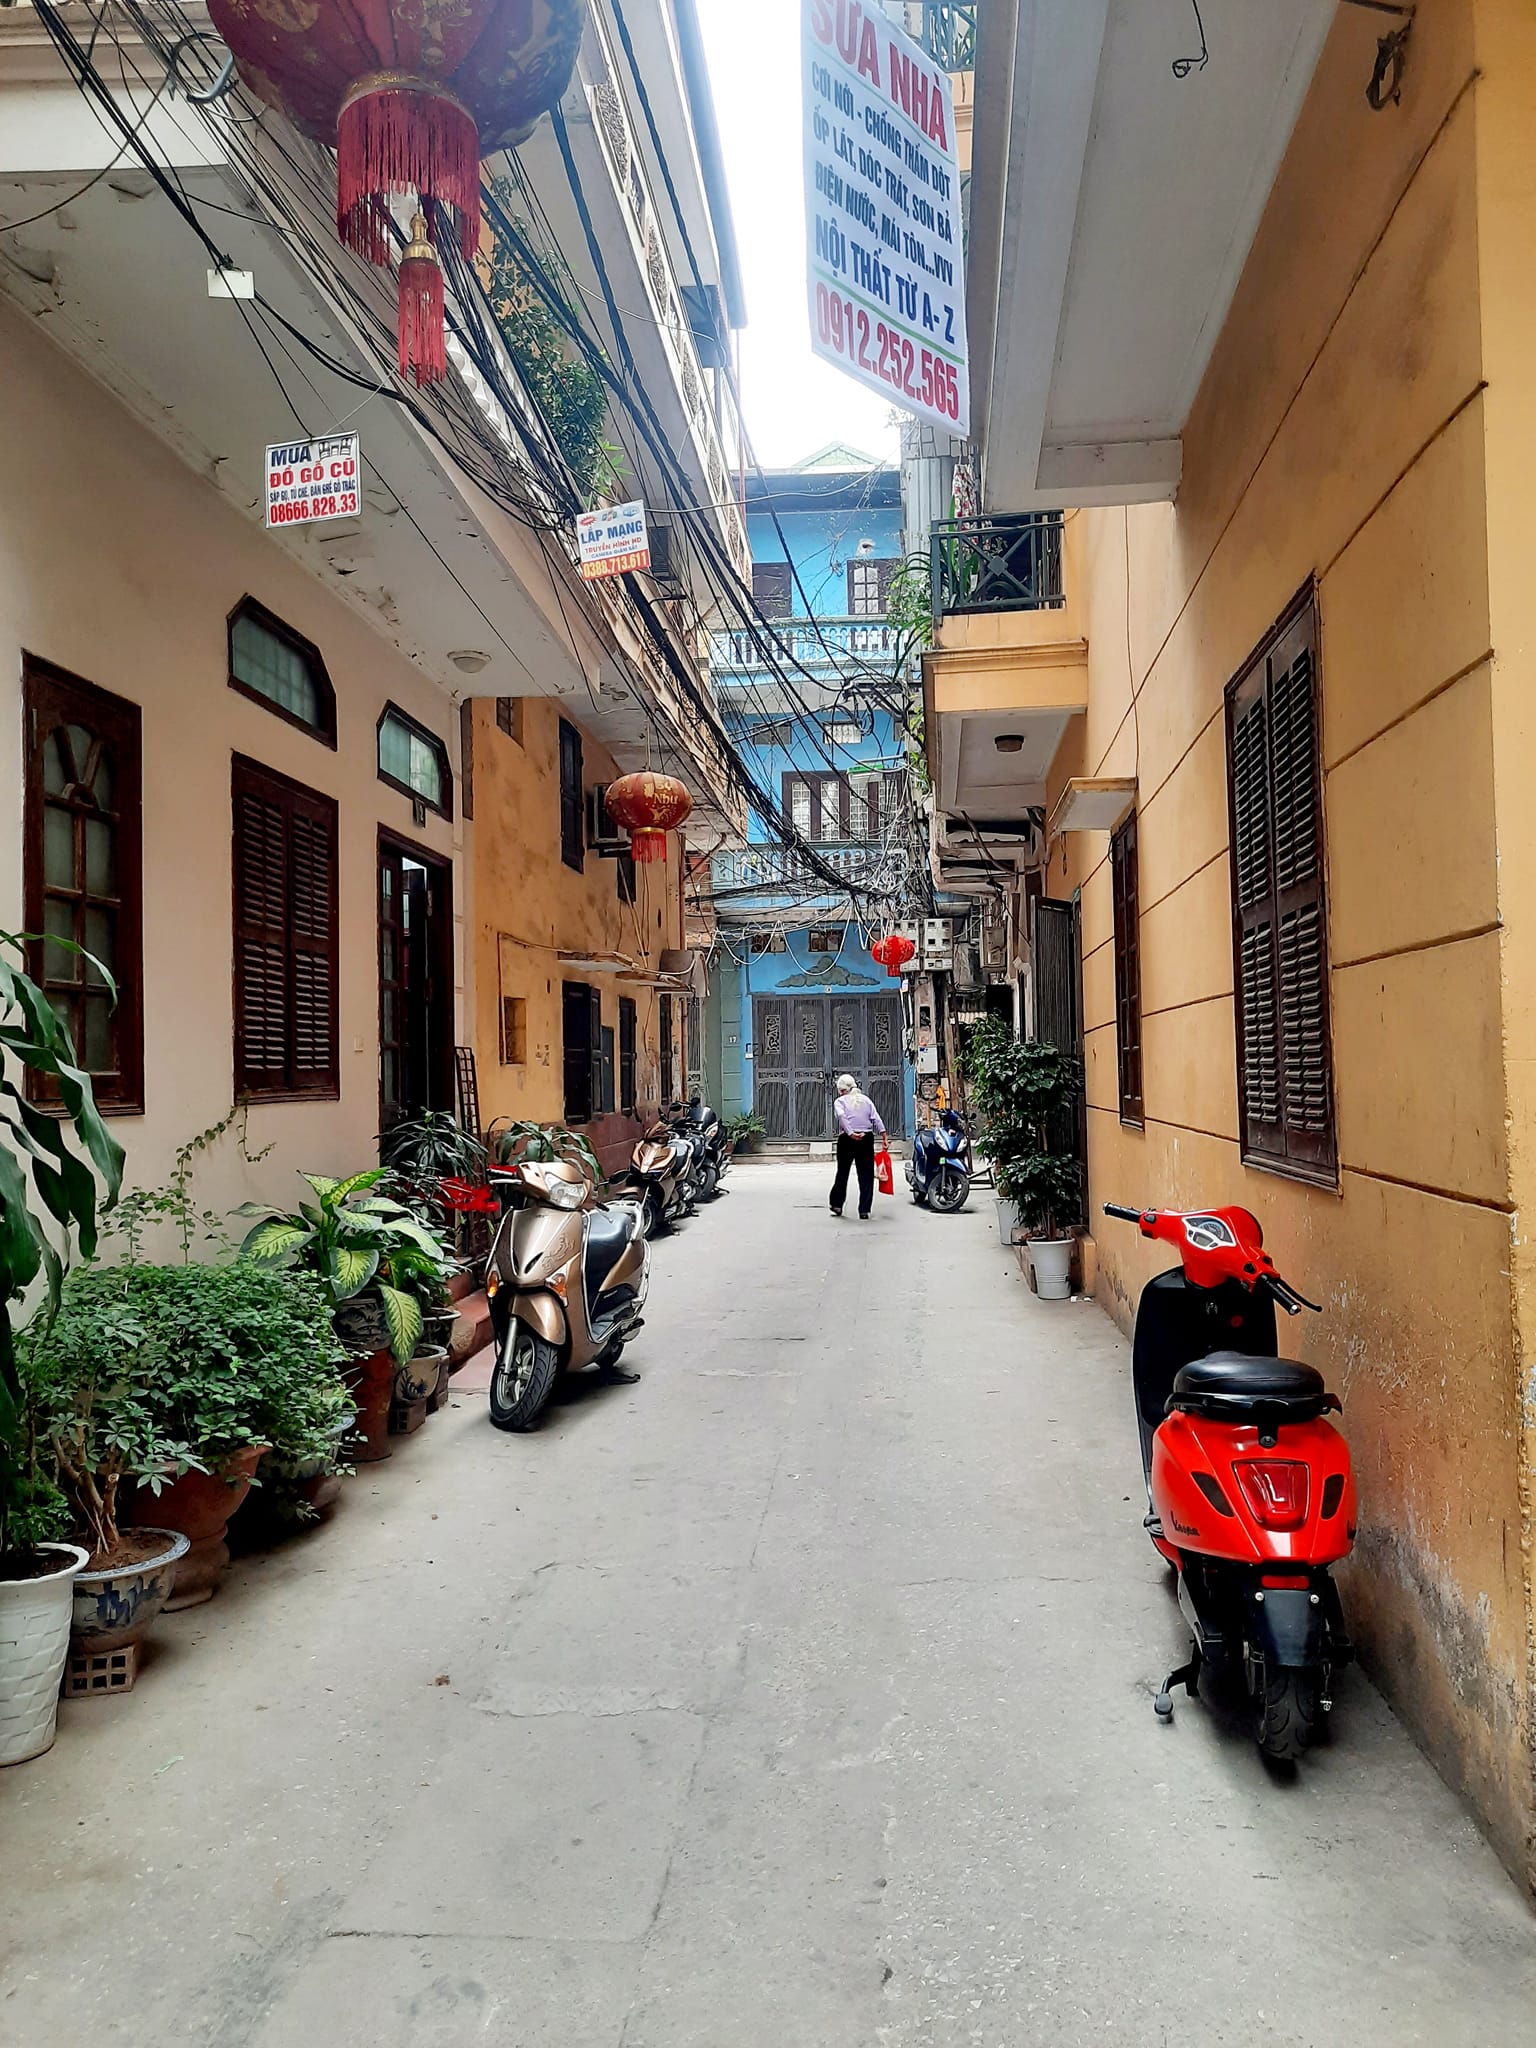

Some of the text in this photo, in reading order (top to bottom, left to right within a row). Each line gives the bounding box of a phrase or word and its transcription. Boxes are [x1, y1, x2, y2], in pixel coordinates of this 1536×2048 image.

[889, 42, 948, 152] NHÀ
[834, 79, 855, 120] NỚI
[864, 105, 902, 159] CHỐNG
[904, 138, 930, 186] THẤM
[931, 164, 951, 202] DỘT
[813, 104, 952, 244] ỐP LÁT, DÓC TRÁT, SƠN BẢ
[846, 183, 879, 239] NƯỚC,
[881, 213, 901, 254] MÁI
[815, 213, 847, 278] NỘI
[850, 240, 892, 306] THẤT
[895, 272, 918, 321] TỪ
[816, 281, 959, 420] 0912.252.565
[269, 457, 355, 489] ĐỒ GỖ CŨ
[271, 445, 312, 467] MUA
[270, 493, 357, 524] 08666.828.33
[606, 520, 643, 540] MẠNG
[583, 551, 647, 578] 0388.713.611
[653, 792, 679, 805] Như
